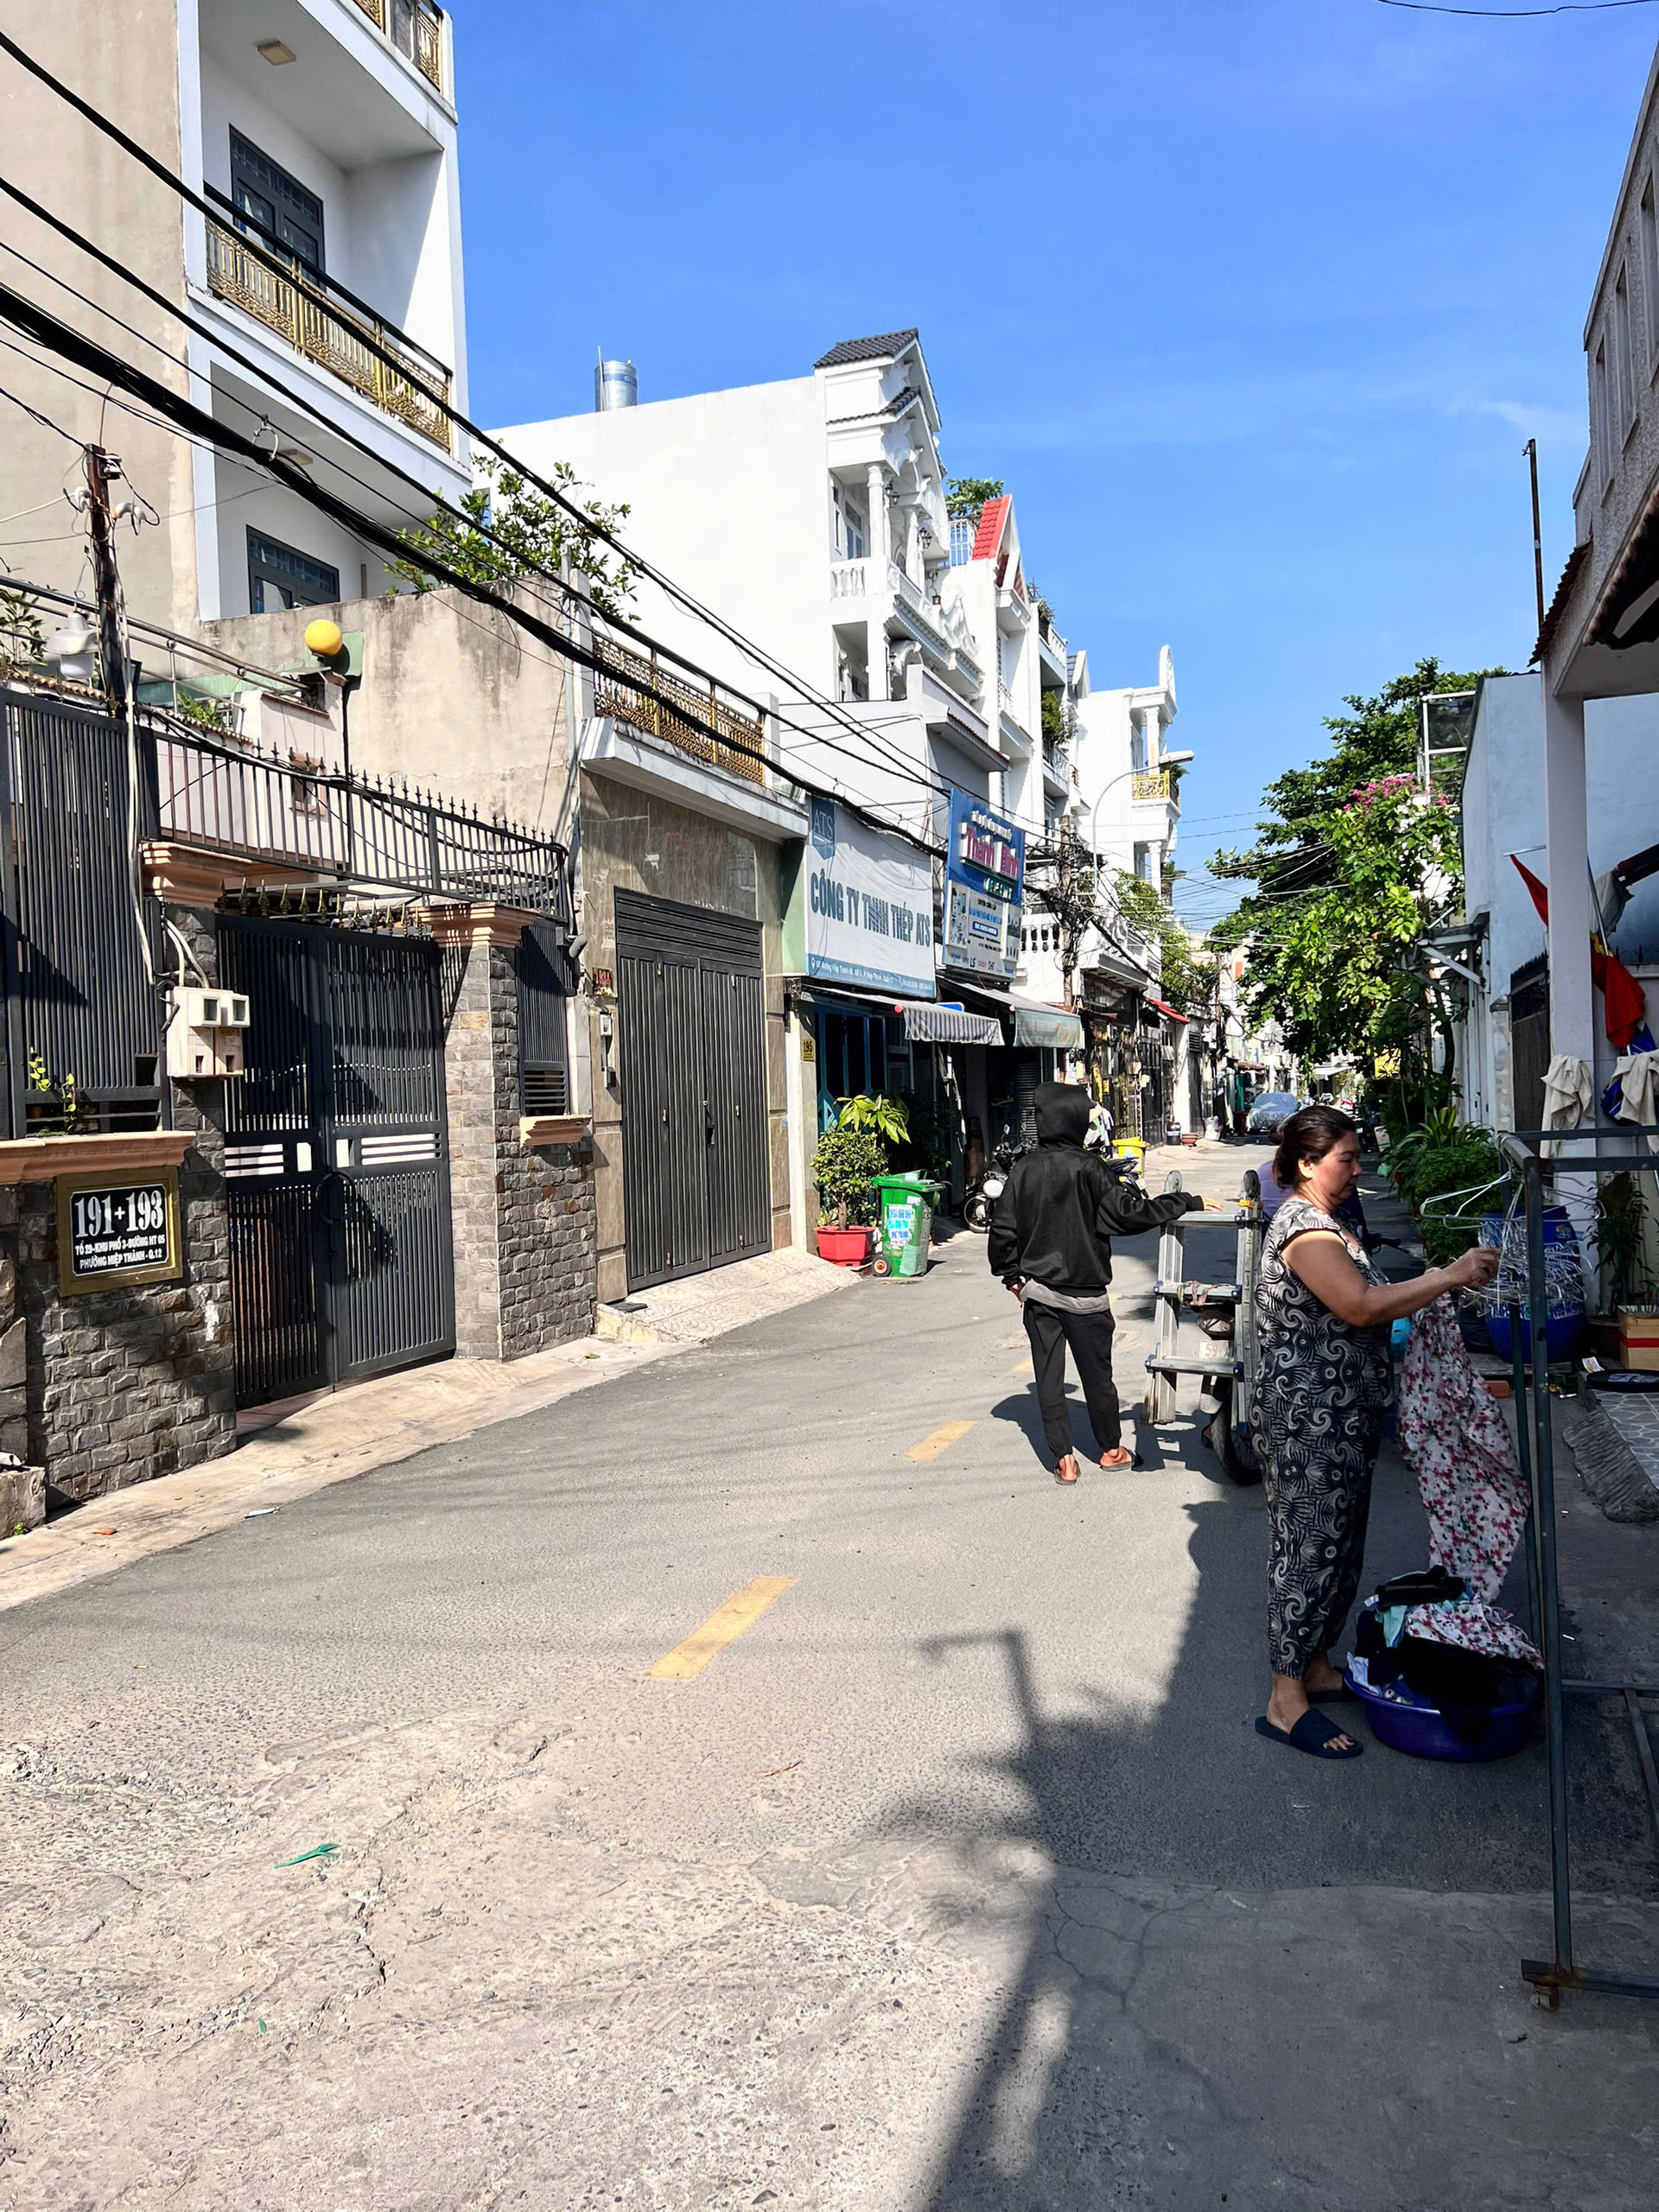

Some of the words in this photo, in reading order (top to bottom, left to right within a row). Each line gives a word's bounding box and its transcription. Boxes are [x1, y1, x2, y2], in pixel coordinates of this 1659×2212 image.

[814, 809, 833, 839] ATS
[810, 868, 844, 922] CÔNG
[847, 886, 860, 926] TY
[862, 892, 889, 937] TNHH
[891, 901, 913, 943] THÉP
[916, 912, 931, 947] ATS
[804, 1040, 813, 1053] 195
[75, 1240, 85, 1255] TỔ
[109, 1236, 122, 1251] PHỐ
[149, 1236, 157, 1245] HT
[79, 1254, 107, 1269] PHƯỜNG
[107, 1253, 123, 1267] HIỆP
[124, 1249, 145, 1263] THÀNH
